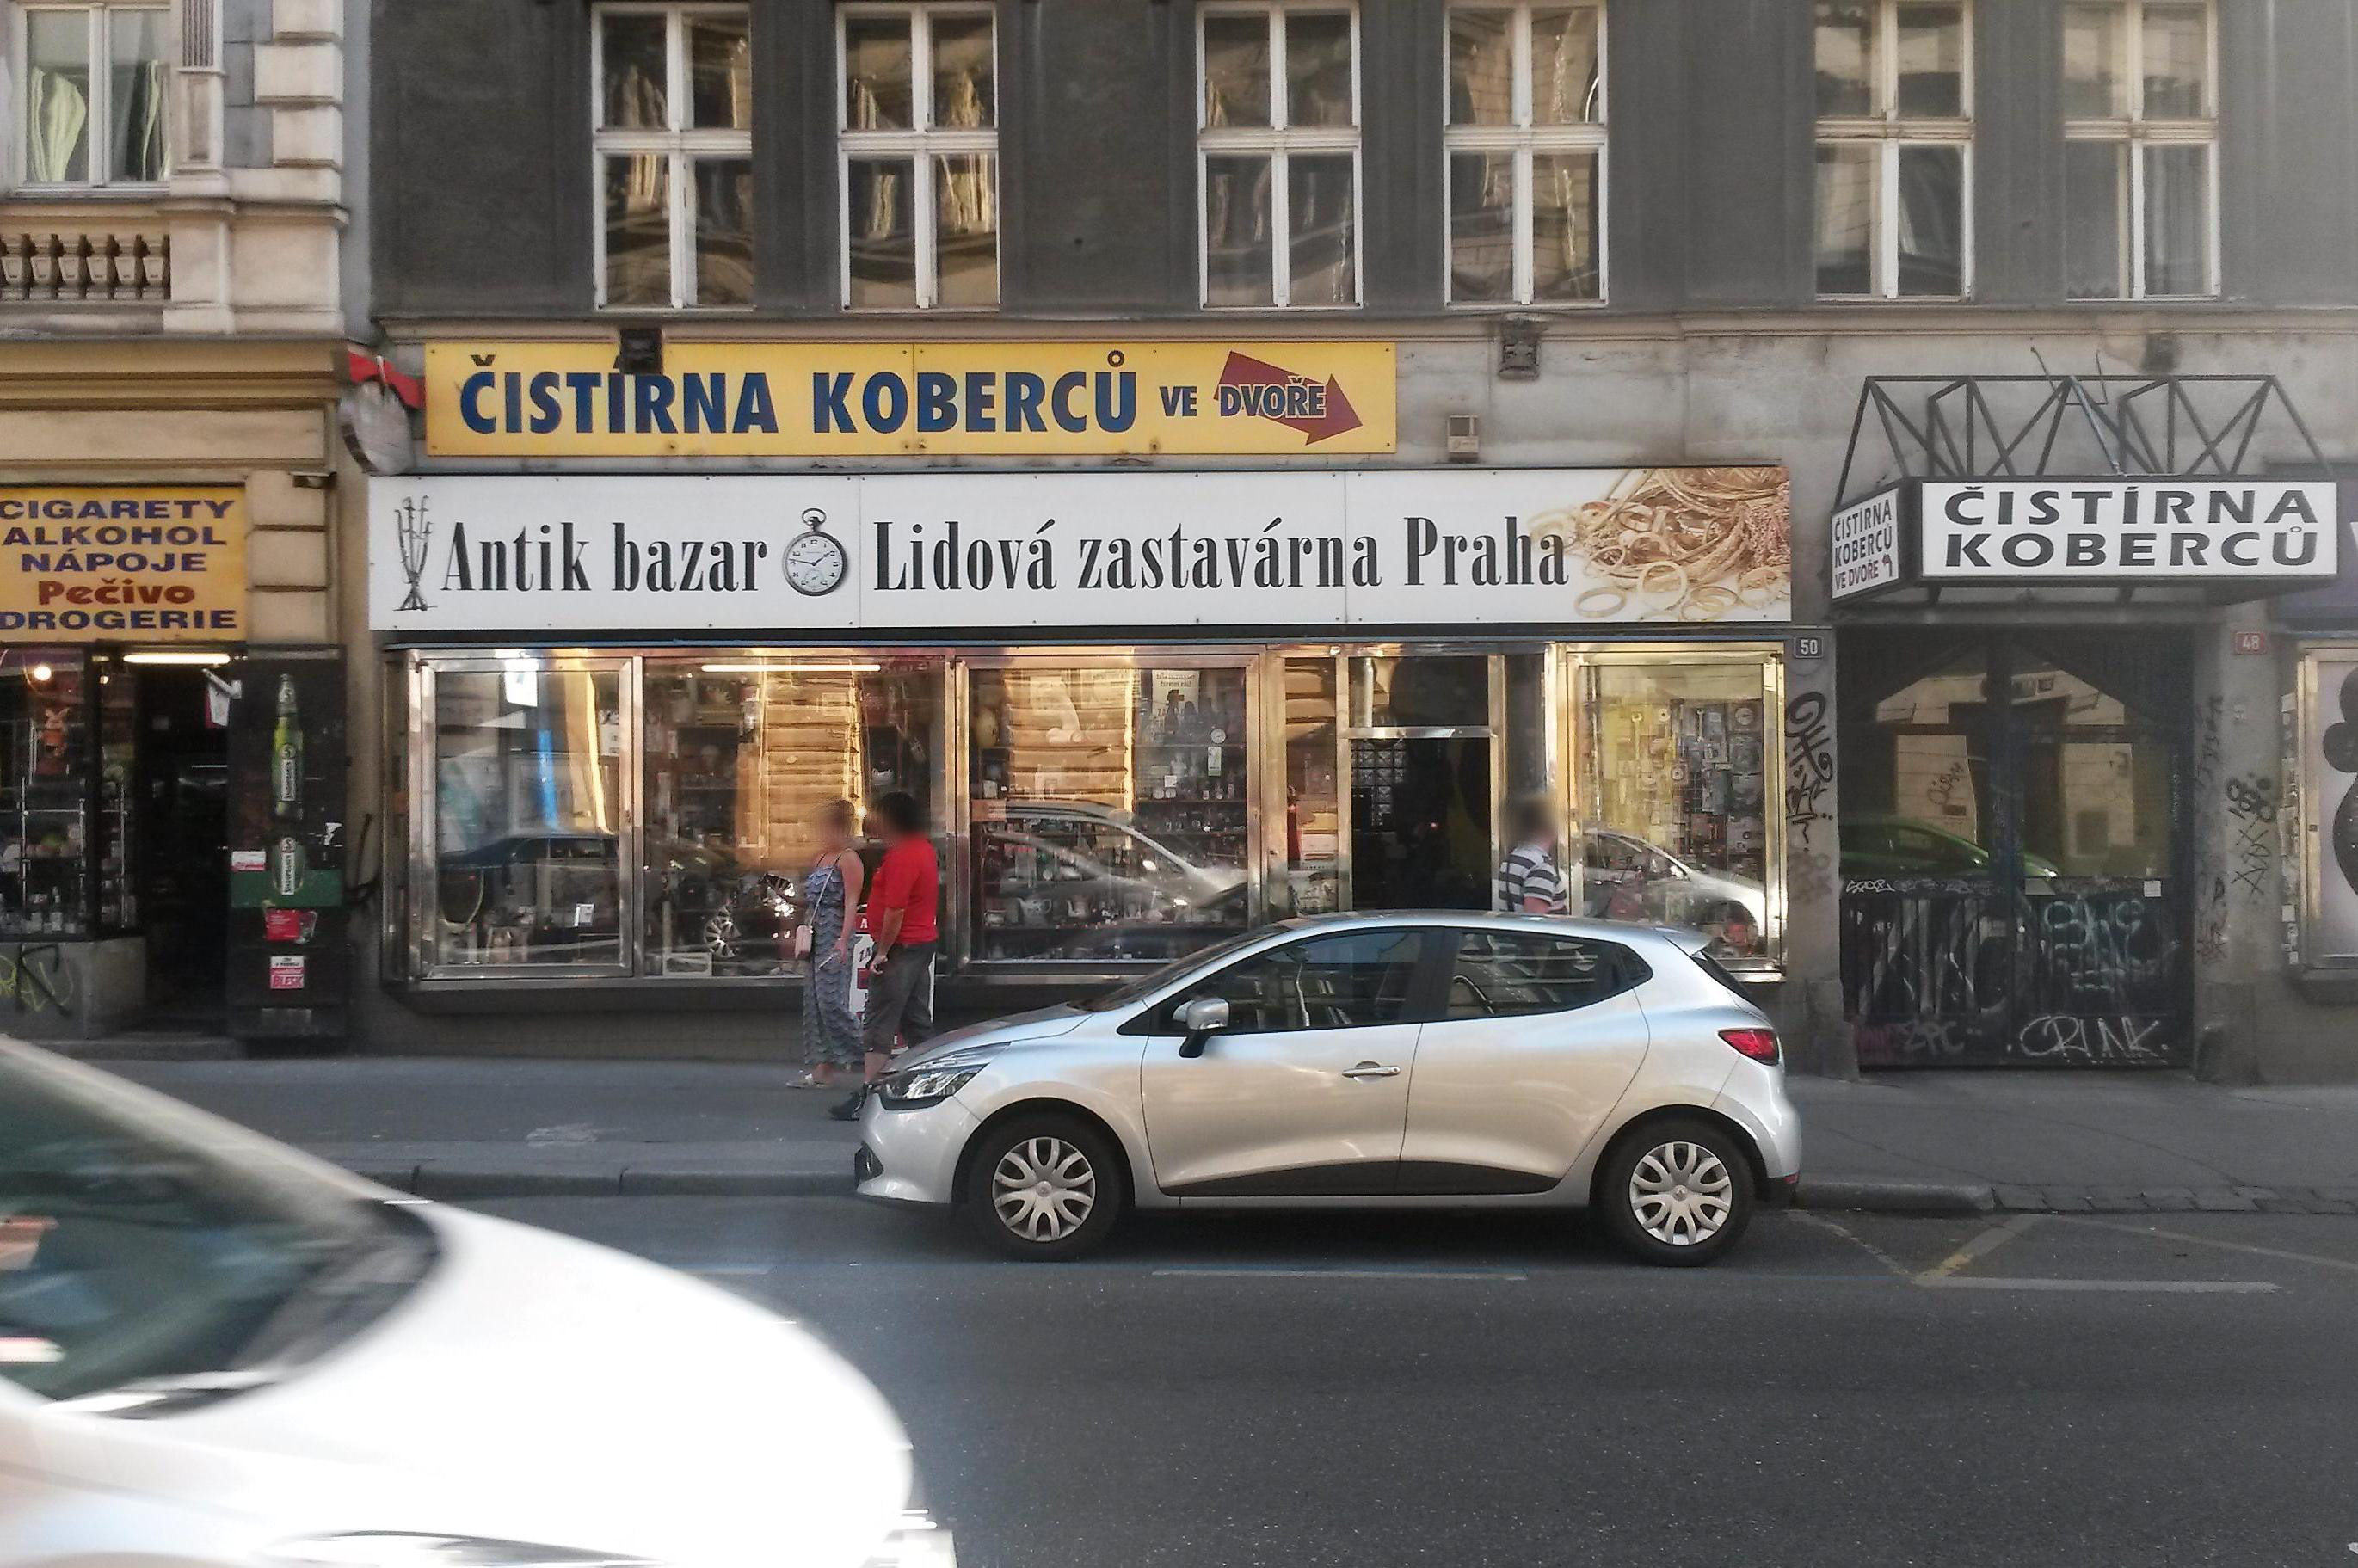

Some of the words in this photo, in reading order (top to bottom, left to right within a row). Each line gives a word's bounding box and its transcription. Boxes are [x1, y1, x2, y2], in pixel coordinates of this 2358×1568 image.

[460, 354, 779, 434] ČISTÍRNA
[813, 349, 1136, 434] KOBERCŮ
[1160, 386, 1197, 417] VE
[1219, 374, 1327, 419] DVOŘE
[0, 500, 235, 520] CIGARETY
[1944, 485, 2318, 525] ČISTÍRNA
[2, 526, 227, 546] ALKOHOL
[1945, 526, 2318, 568] KOBERCŮ
[22, 548, 207, 573] NÁPOJE
[441, 521, 592, 592] Antik
[612, 522, 768, 593] bazar
[873, 518, 1057, 591] Lidová
[1077, 517, 1382, 589] zastavárna
[1404, 516, 1570, 587] Praha
[38, 577, 196, 606] Pečivo
[1834, 570, 1846, 591] VE
[0, 609, 237, 630] DROGERIE
[1800, 638, 1818, 655] 50
[2243, 634, 2260, 651] 48
